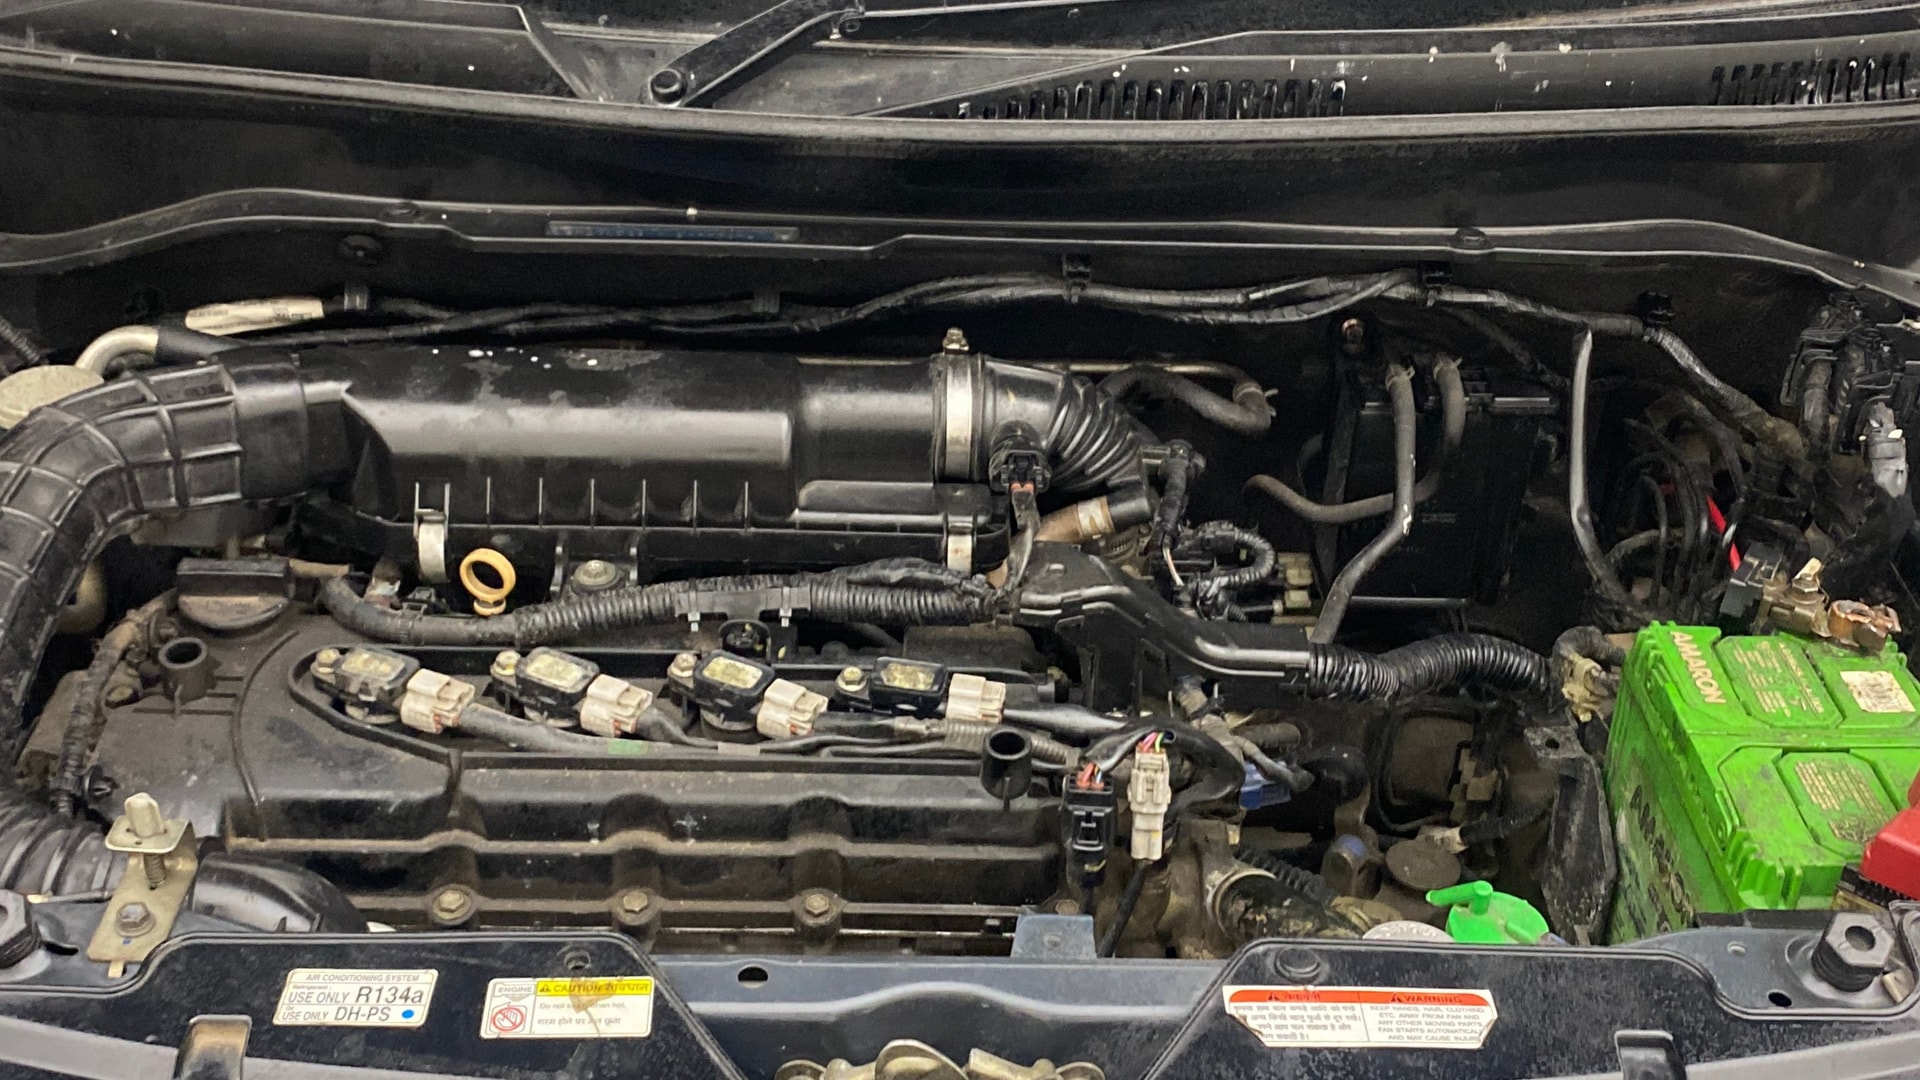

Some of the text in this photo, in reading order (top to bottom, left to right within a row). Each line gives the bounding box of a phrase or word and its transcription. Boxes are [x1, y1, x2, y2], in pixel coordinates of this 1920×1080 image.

[1670, 631, 1727, 703] AMARON
[322, 974, 383, 982] CONDITIONING
[385, 974, 420, 982] SYSTEM
[289, 986, 424, 1004] USE ONLY R134a
[553, 984, 601, 994] CAUTION
[1405, 996, 1462, 1004] WARNING
[282, 1006, 392, 1021] USE ONLY DH-PS
